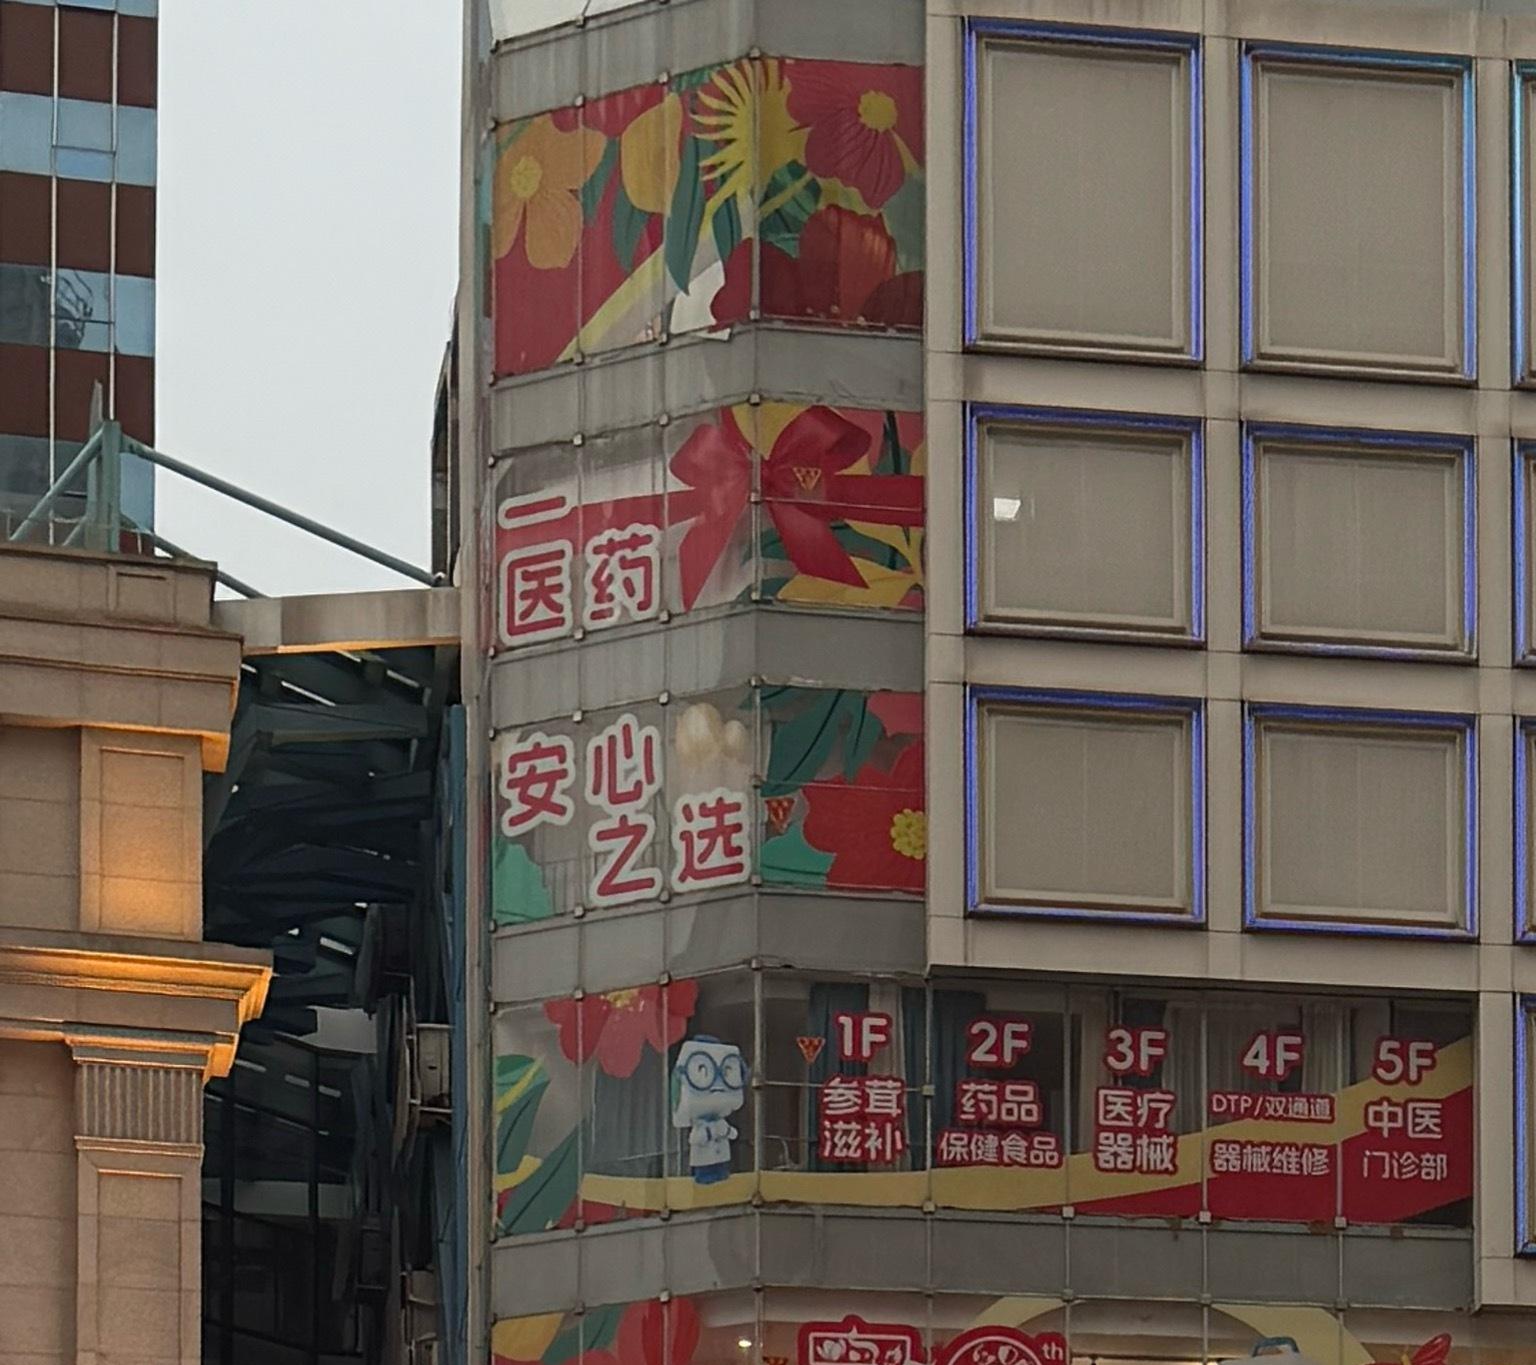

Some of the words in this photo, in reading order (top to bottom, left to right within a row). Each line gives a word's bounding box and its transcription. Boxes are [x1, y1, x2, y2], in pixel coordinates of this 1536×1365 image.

[837, 1015, 888, 1057] 1F
[970, 1021, 1030, 1063] 2F
[1107, 1029, 1166, 1071] 3F
[1243, 1035, 1303, 1075] 4F
[1375, 1040, 1434, 1082] 5F
[822, 1078, 902, 1117] 参茸
[960, 1082, 1039, 1122] 药品
[1098, 1089, 1175, 1130] 医疗
[1367, 1101, 1443, 1139] 中医
[823, 1122, 902, 1160] 滋补
[939, 1132, 1060, 1166] 保健食品
[1098, 1134, 1175, 1173] 器械
[1213, 1143, 1331, 1177] 器械维修
[1362, 1151, 1448, 1181] 门诊部
